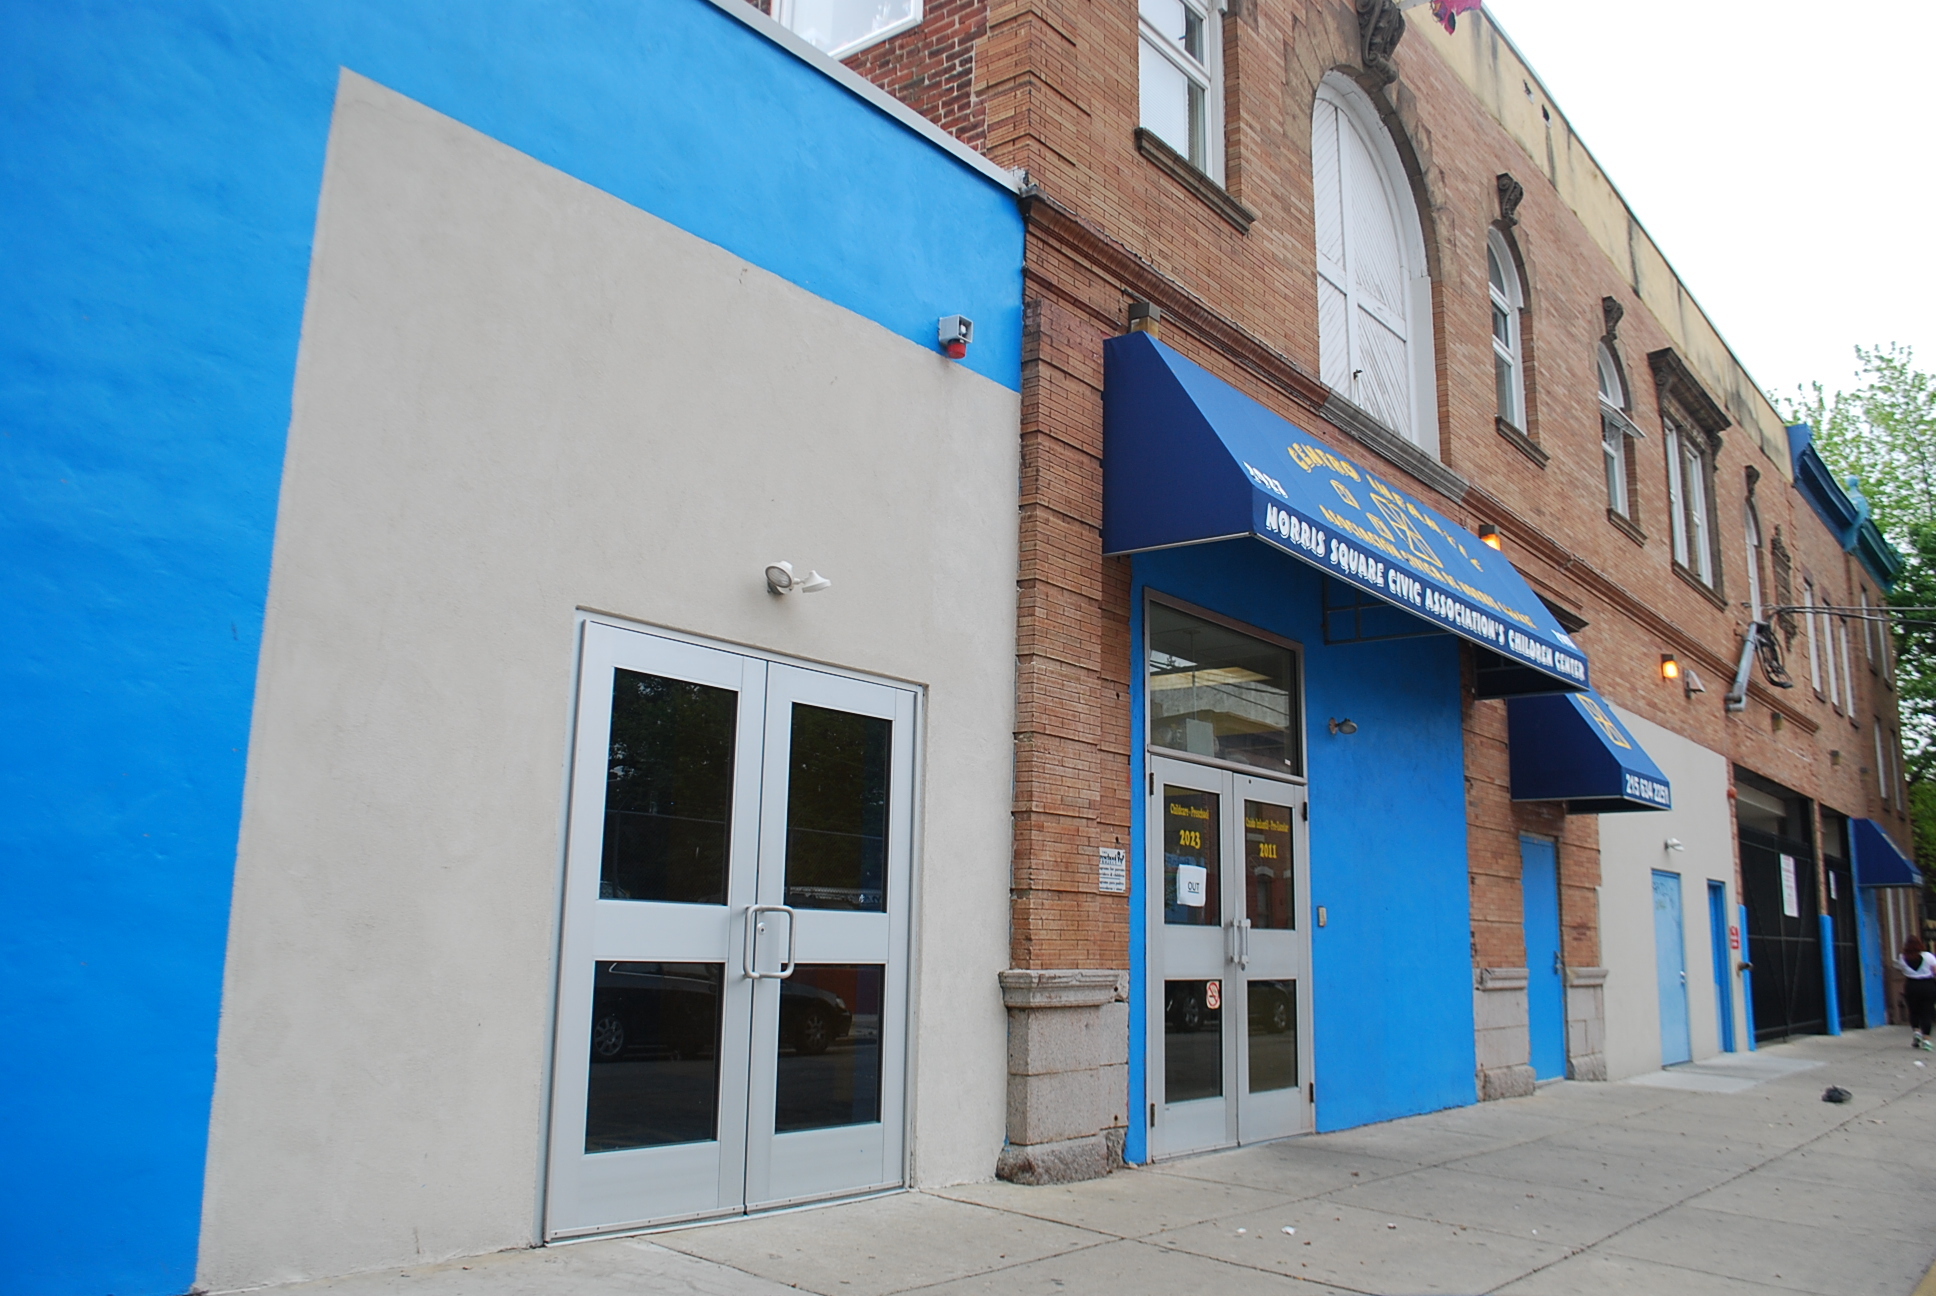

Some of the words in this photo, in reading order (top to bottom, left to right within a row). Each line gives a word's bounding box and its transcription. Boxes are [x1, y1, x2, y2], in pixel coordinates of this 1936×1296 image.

[1287, 442, 1361, 483] CENTRO
[1266, 502, 1325, 558] NORRIS
[1330, 538, 1385, 587] SQUARE
[1388, 568, 1422, 606] CIVIC
[1424, 587, 1505, 645] ASSOCIATION'S
[1508, 629, 1553, 667] CHILDREN
[1554, 651, 1586, 681] CENTER
[1625, 773, 1640, 797] 215
[1640, 778, 1654, 800] 634
[1179, 829, 1202, 850] 2023
[1259, 843, 1278, 858] 2011
[1187, 881, 1200, 891] OUT
